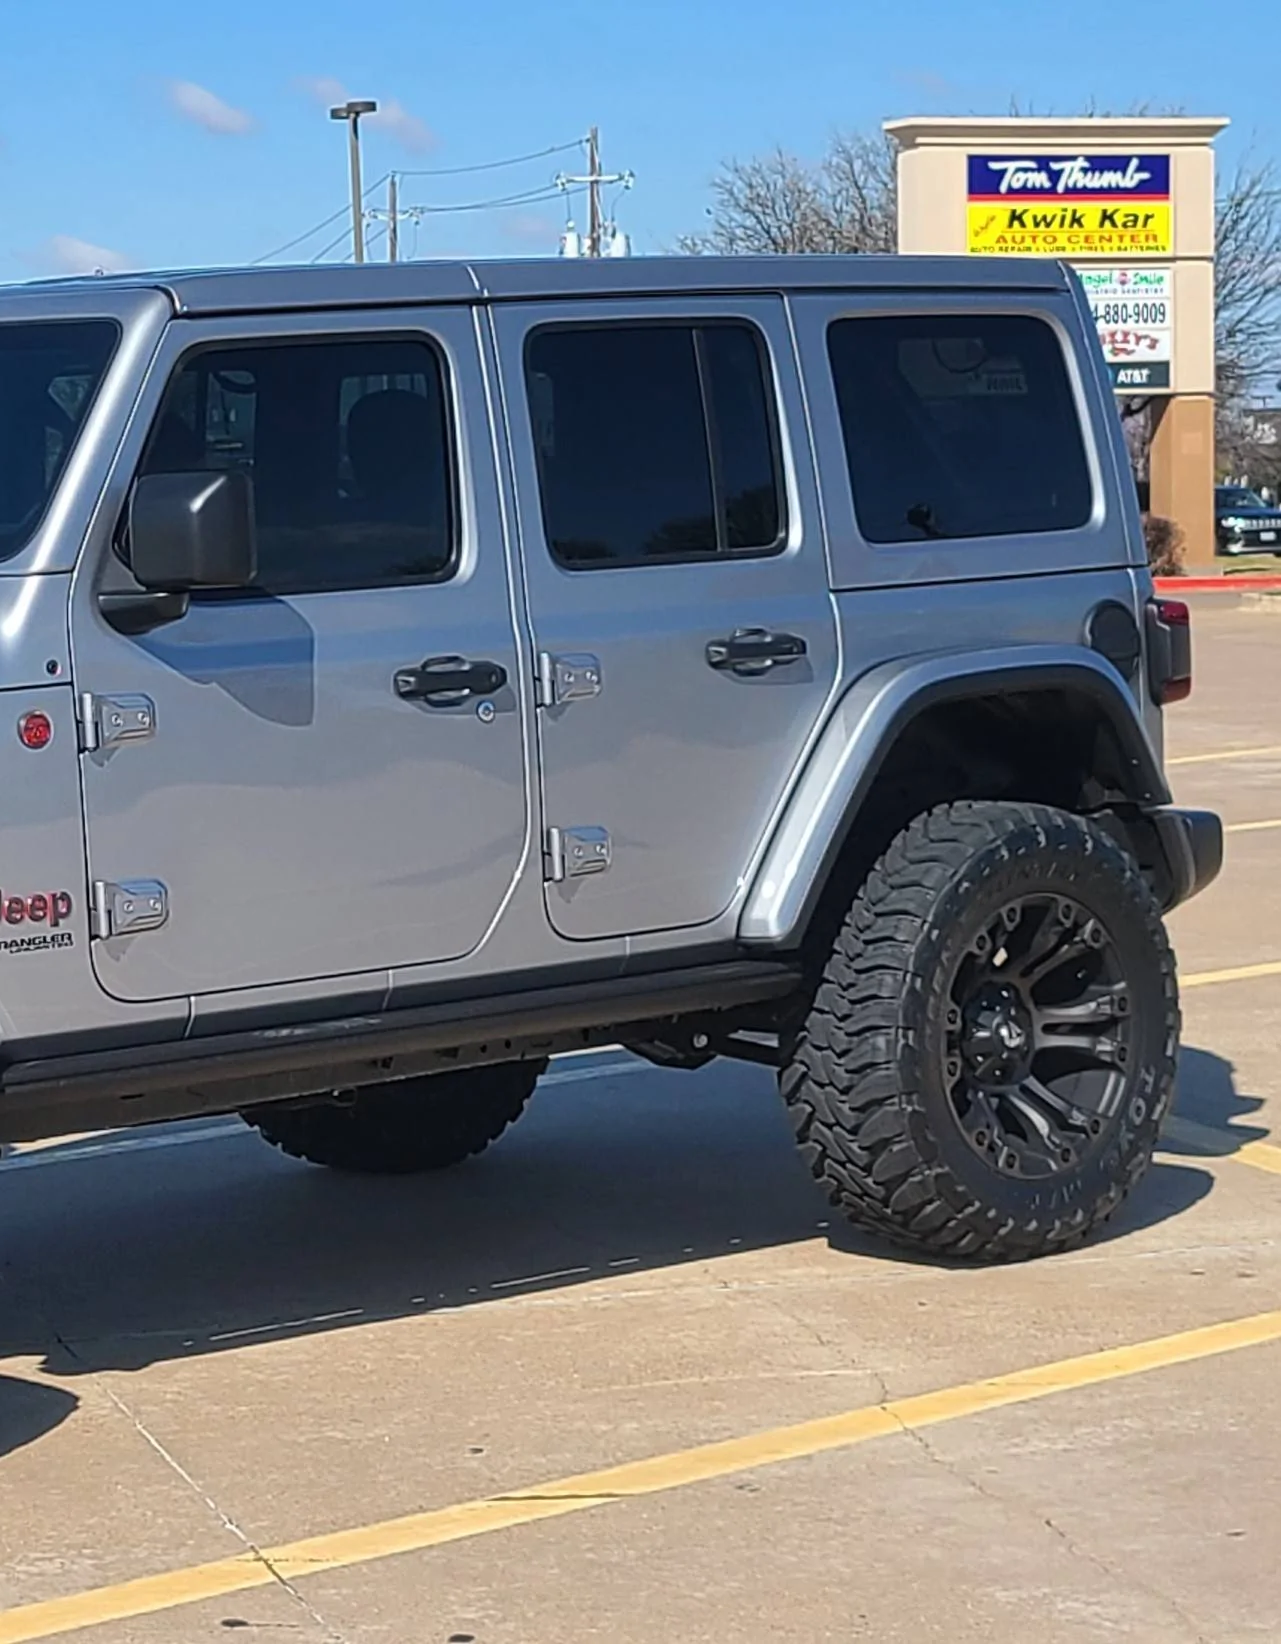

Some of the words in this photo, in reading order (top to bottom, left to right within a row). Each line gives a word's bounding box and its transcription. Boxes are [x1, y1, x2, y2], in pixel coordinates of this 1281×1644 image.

[987, 160, 1052, 194] Tom
[1049, 156, 1151, 194] Thumb
[1006, 208, 1086, 229] Kwik
[1098, 208, 1155, 229] Kar
[995, 234, 1058, 244] AUTO
[1067, 233, 1158, 244] CENTER
[1117, 368, 1150, 384] AT&T
